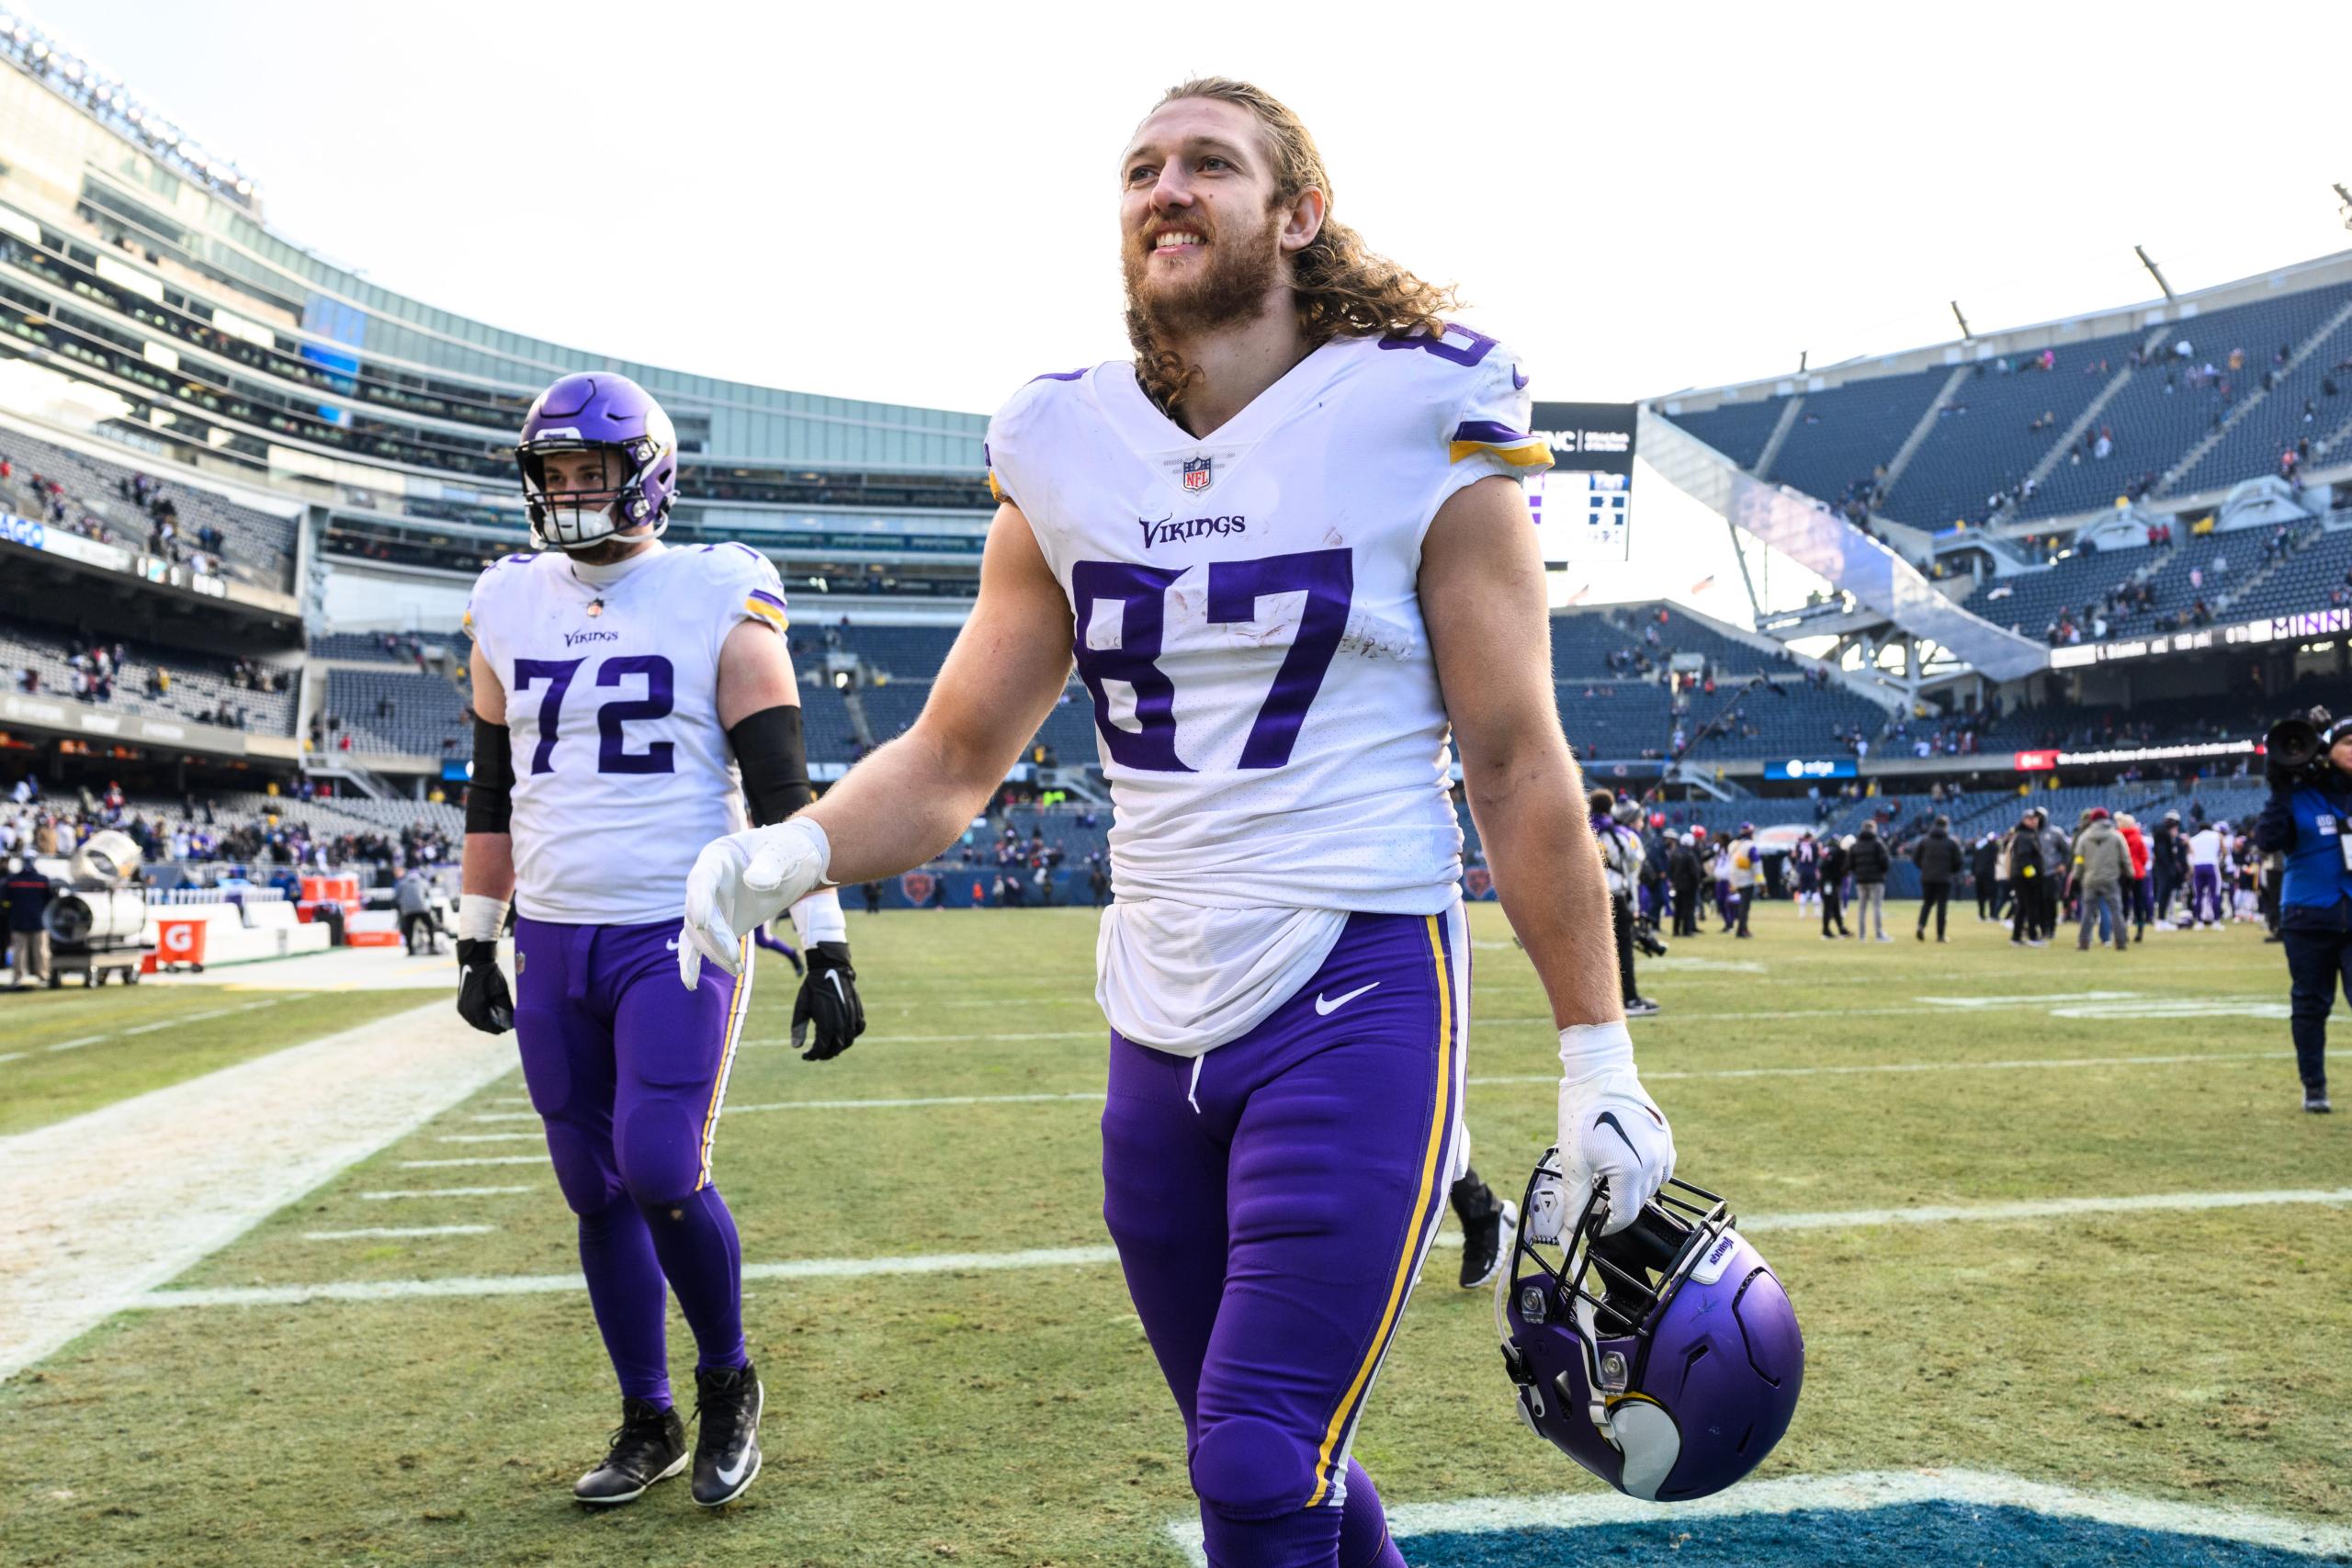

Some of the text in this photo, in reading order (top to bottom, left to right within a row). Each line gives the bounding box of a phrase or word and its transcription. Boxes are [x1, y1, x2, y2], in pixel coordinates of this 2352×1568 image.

[1534, 430, 1576, 452] NC
[1186, 470, 1208, 488] NFL
[2272, 608, 2352, 640] MINN
[1071, 547, 1354, 773] 87
[514, 655, 675, 775] 72
[165, 925, 192, 952] G
